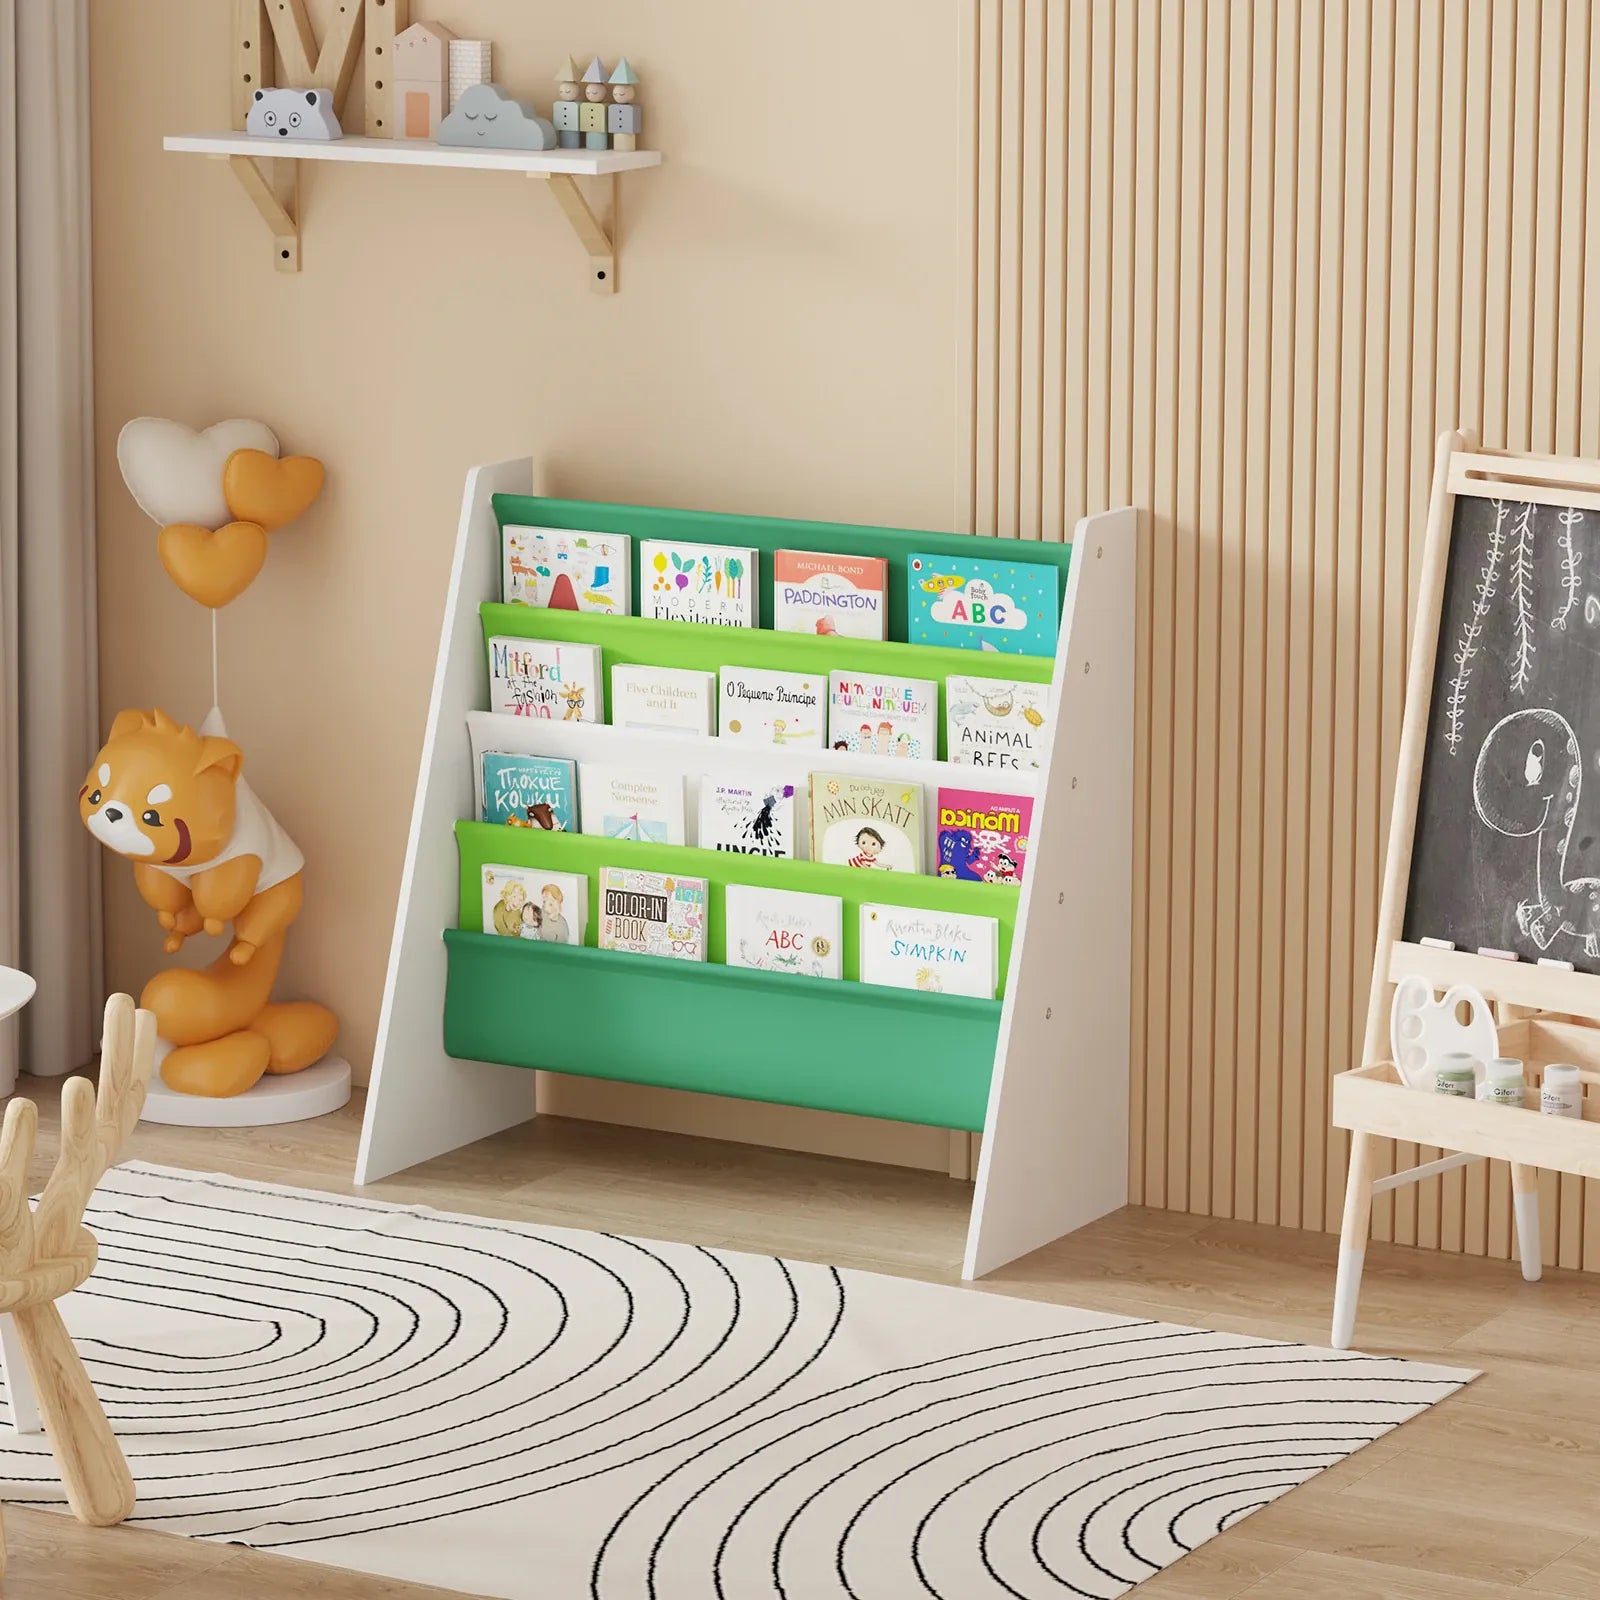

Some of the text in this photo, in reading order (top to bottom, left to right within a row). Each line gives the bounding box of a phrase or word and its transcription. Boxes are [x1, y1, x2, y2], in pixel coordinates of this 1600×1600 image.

[797, 562, 864, 575] MICHAEL BOND
[653, 595, 744, 613] MODERN
[951, 600, 1008, 624] ABC
[493, 643, 562, 682] Mitford
[521, 676, 537, 689] the
[626, 682, 697, 699] Five Children
[727, 681, 735, 697] O
[737, 681, 774, 703] Pequeno
[646, 699, 667, 709] and
[610, 780, 657, 792] Complete
[728, 788, 752, 797] MARTIN
[849, 784, 859, 792] Du
[611, 792, 659, 805] Nonsense
[823, 796, 915, 828] MIN SKATT
[615, 917, 647, 942] BOOK
[765, 929, 804, 950] ABC
[890, 939, 967, 963] SIMPKIN
